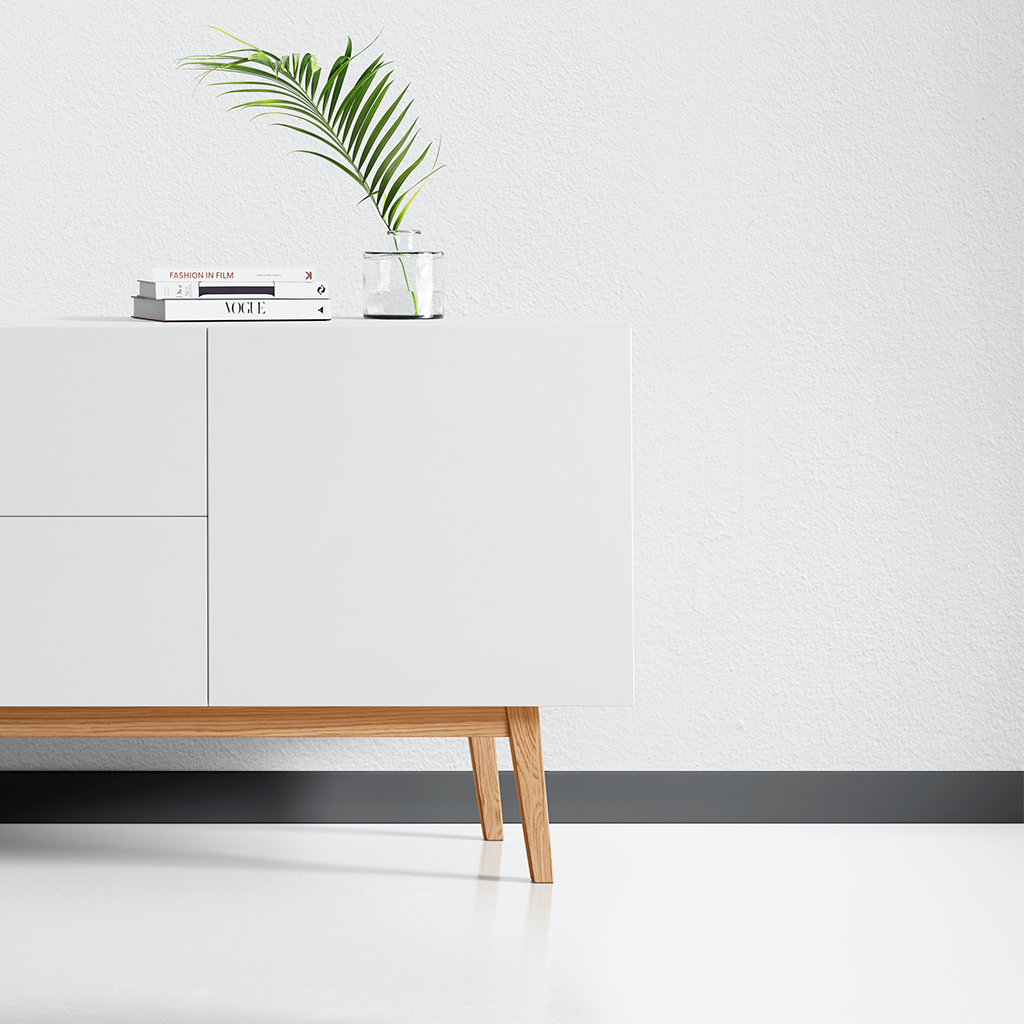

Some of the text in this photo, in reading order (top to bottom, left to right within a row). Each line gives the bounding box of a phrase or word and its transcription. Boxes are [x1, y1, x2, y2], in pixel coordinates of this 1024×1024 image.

[169, 271, 235, 279] FASHION IN FILM
[224, 301, 267, 315] VOGUE
